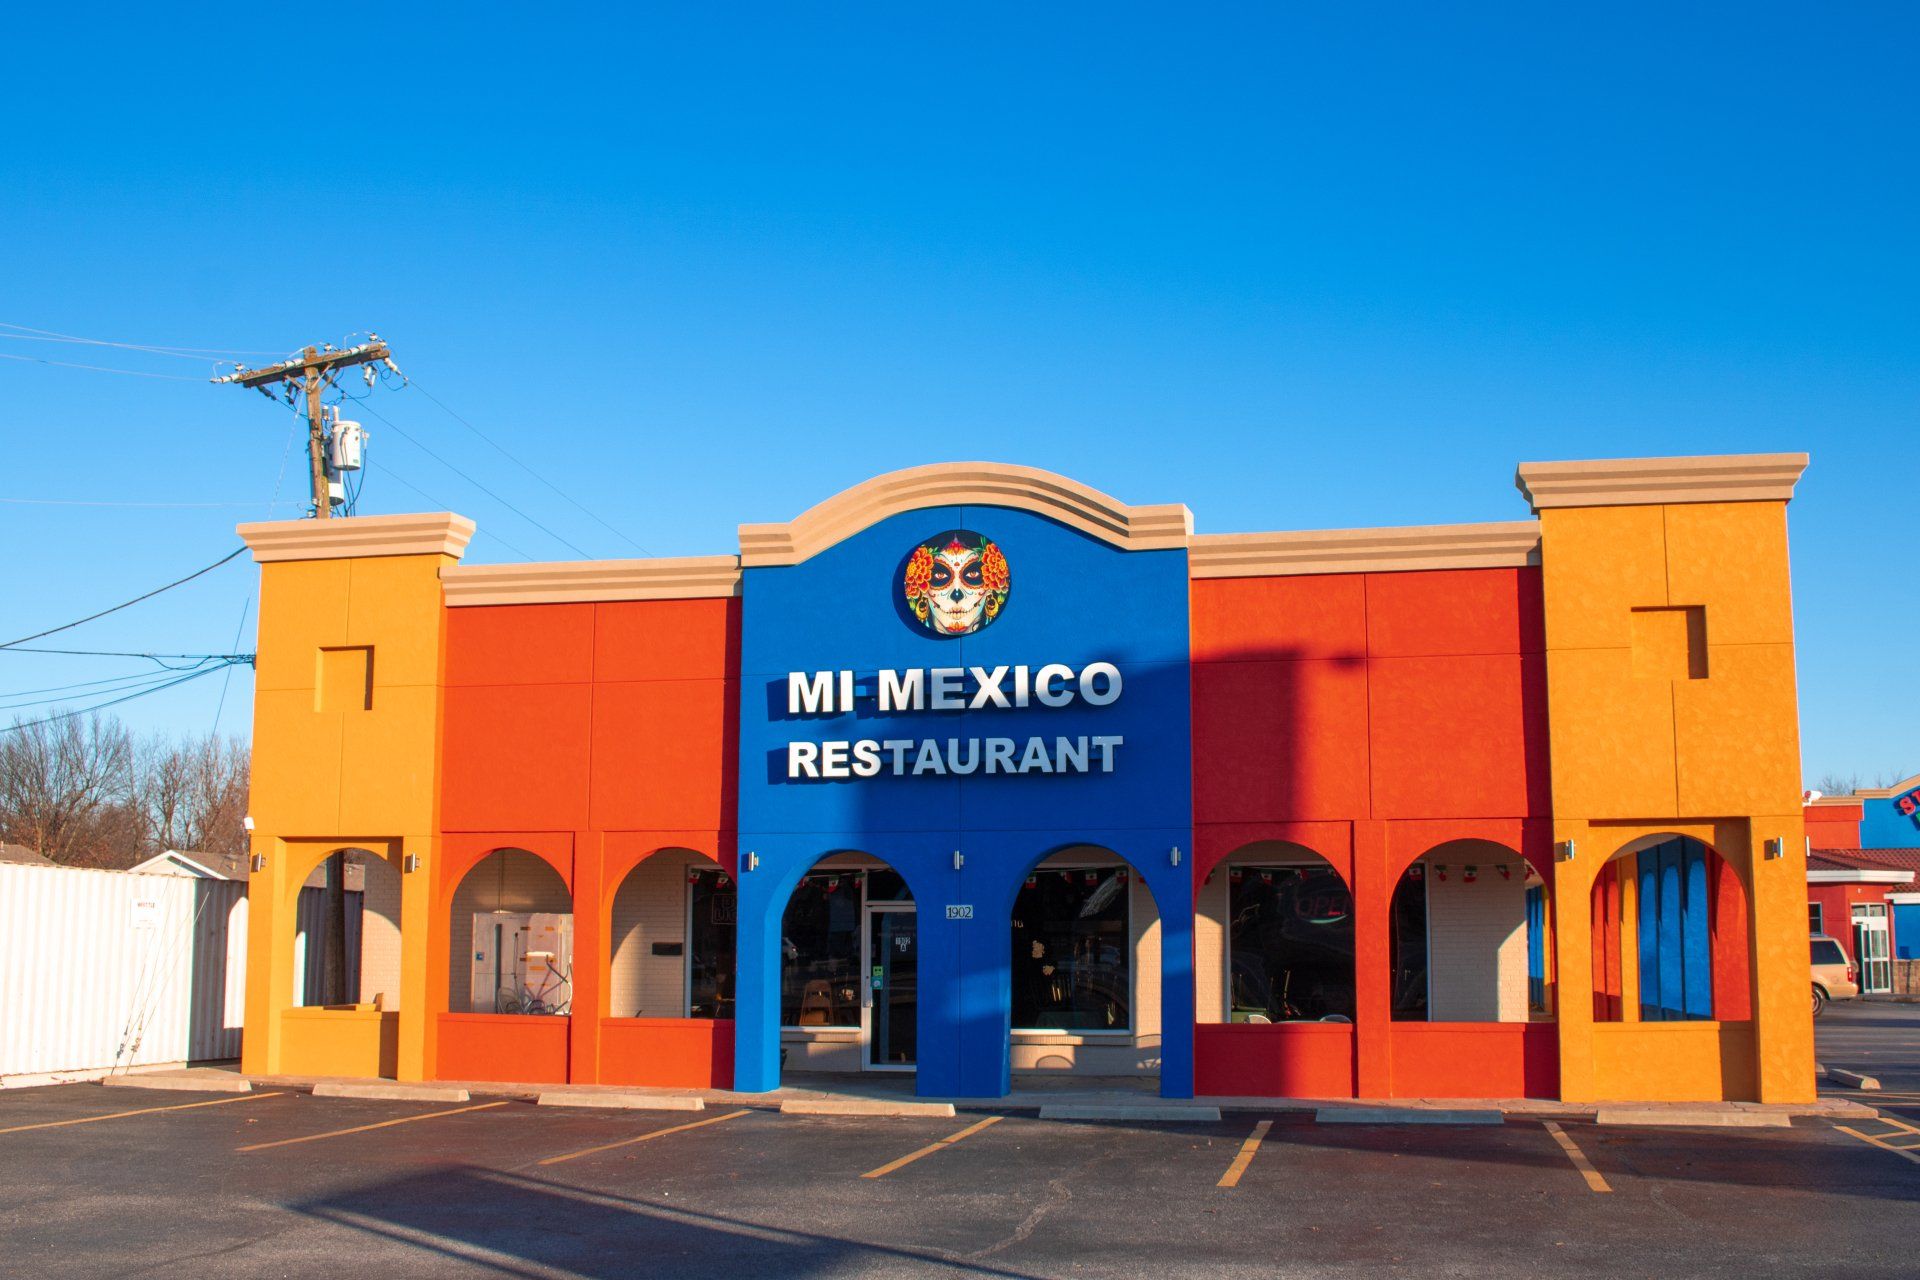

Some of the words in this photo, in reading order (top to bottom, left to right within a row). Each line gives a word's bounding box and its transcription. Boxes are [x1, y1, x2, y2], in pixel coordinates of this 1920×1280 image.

[788, 670, 854, 713] MI
[878, 661, 1123, 711] MEXICO
[788, 735, 1123, 778] RESTAURANT
[946, 906, 972, 918] 1902
